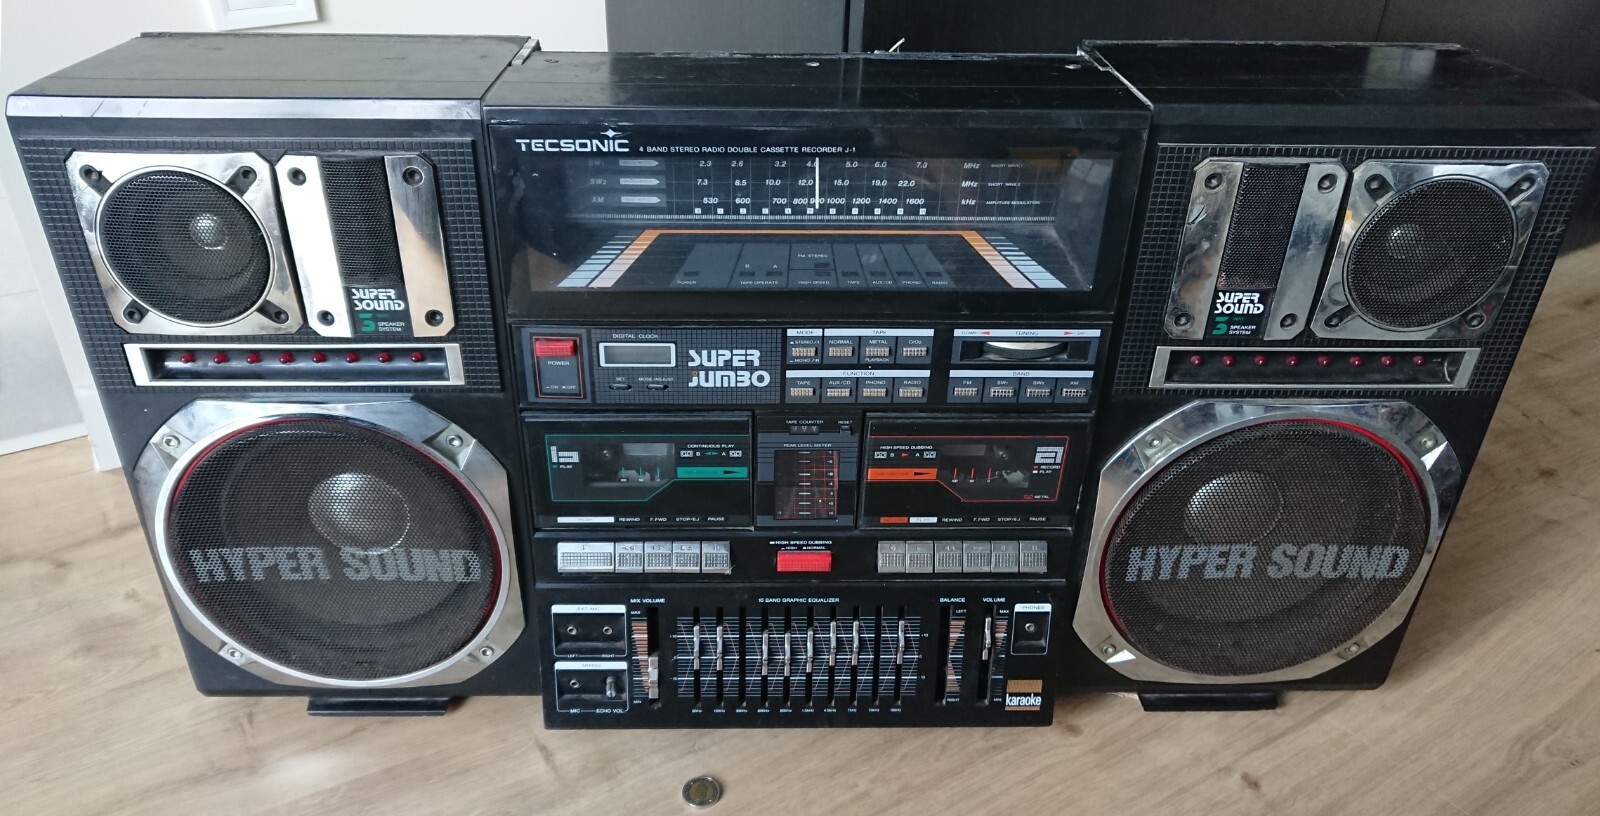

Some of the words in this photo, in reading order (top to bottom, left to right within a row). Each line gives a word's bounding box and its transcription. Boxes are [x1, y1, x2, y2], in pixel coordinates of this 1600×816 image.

[515, 138, 630, 152] TECSONIC
[792, 197, 808, 205] 800
[351, 288, 396, 300] SUPER
[1216, 292, 1261, 304] SUPER
[353, 299, 405, 311] SOUND
[1213, 303, 1264, 314] SOUND
[687, 349, 761, 367] SUPER
[688, 370, 771, 388] JUMBO
[189, 547, 329, 582] HYPER
[339, 546, 481, 582] SOUND
[1125, 543, 1257, 581] HYPER
[1266, 543, 1410, 580] SOUND
[1006, 694, 1042, 706] karaoke
